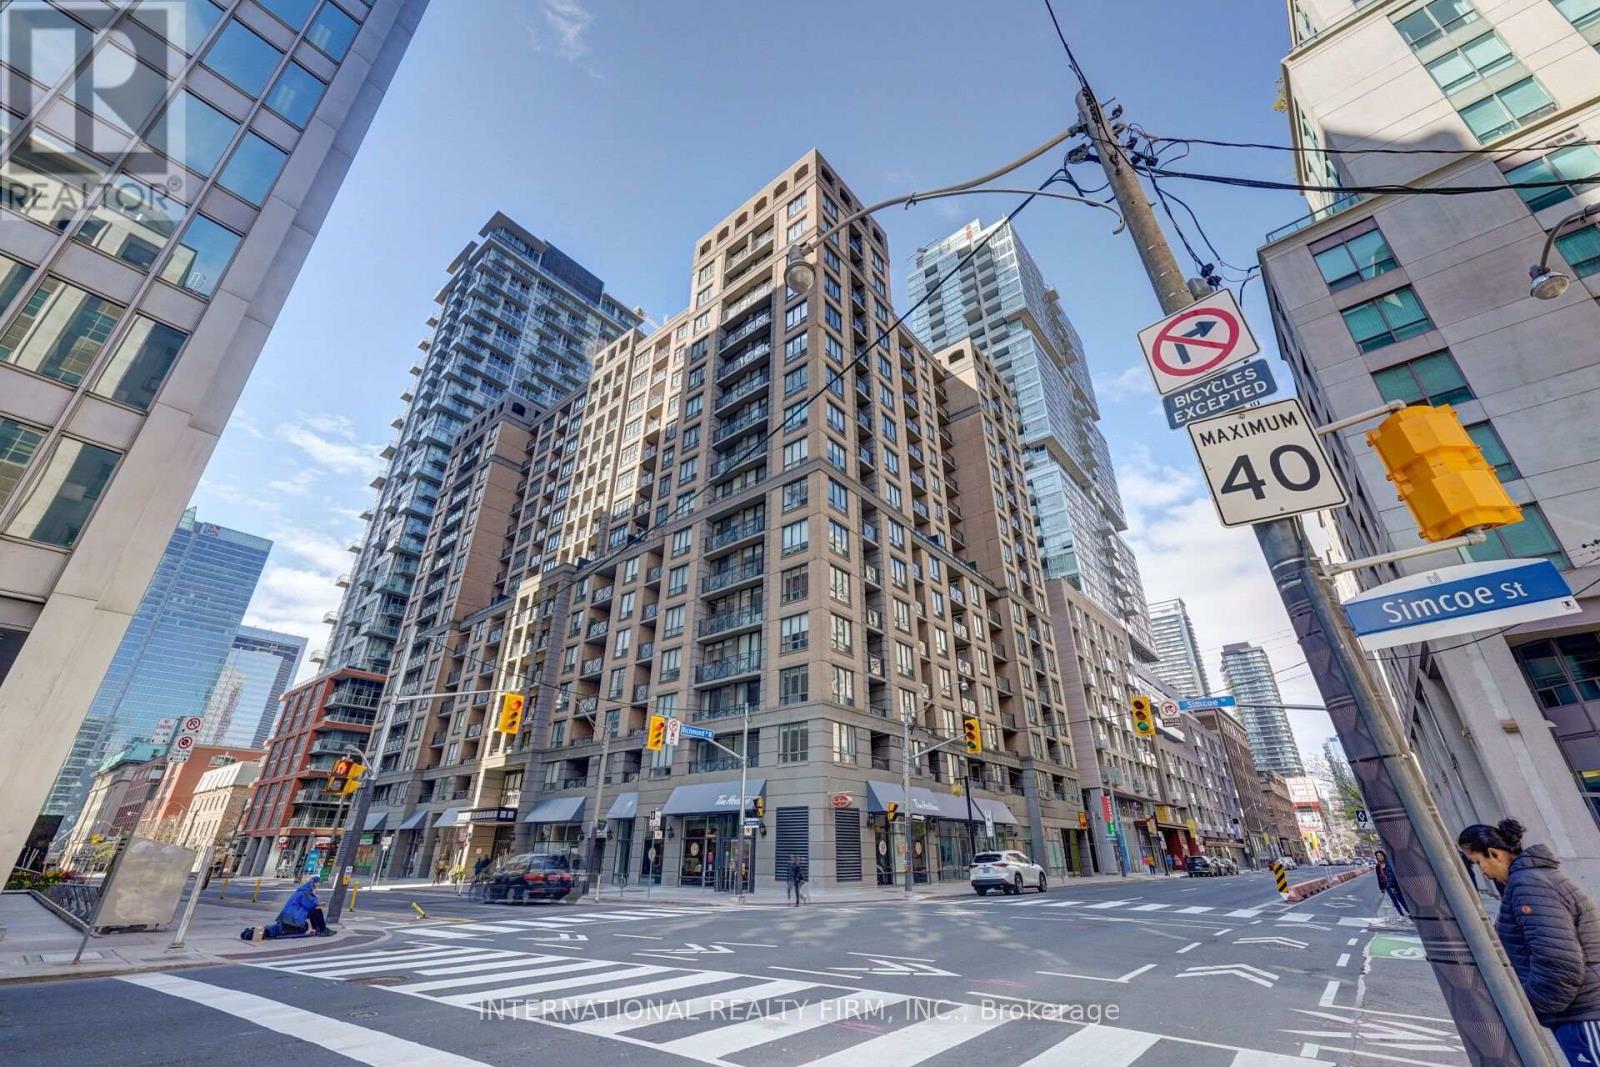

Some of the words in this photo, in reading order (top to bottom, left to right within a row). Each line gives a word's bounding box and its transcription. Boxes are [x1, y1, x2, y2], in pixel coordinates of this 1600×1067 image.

[1174, 368, 1257, 408] BICYCLES
[1174, 381, 1268, 423] EXCEPTED
[1199, 411, 1299, 447] MAXIMUM
[1220, 444, 1321, 501] 40
[1382, 586, 1495, 624] Simcoe
[1500, 581, 1529, 600] St
[1187, 699, 1219, 709] Simcoe
